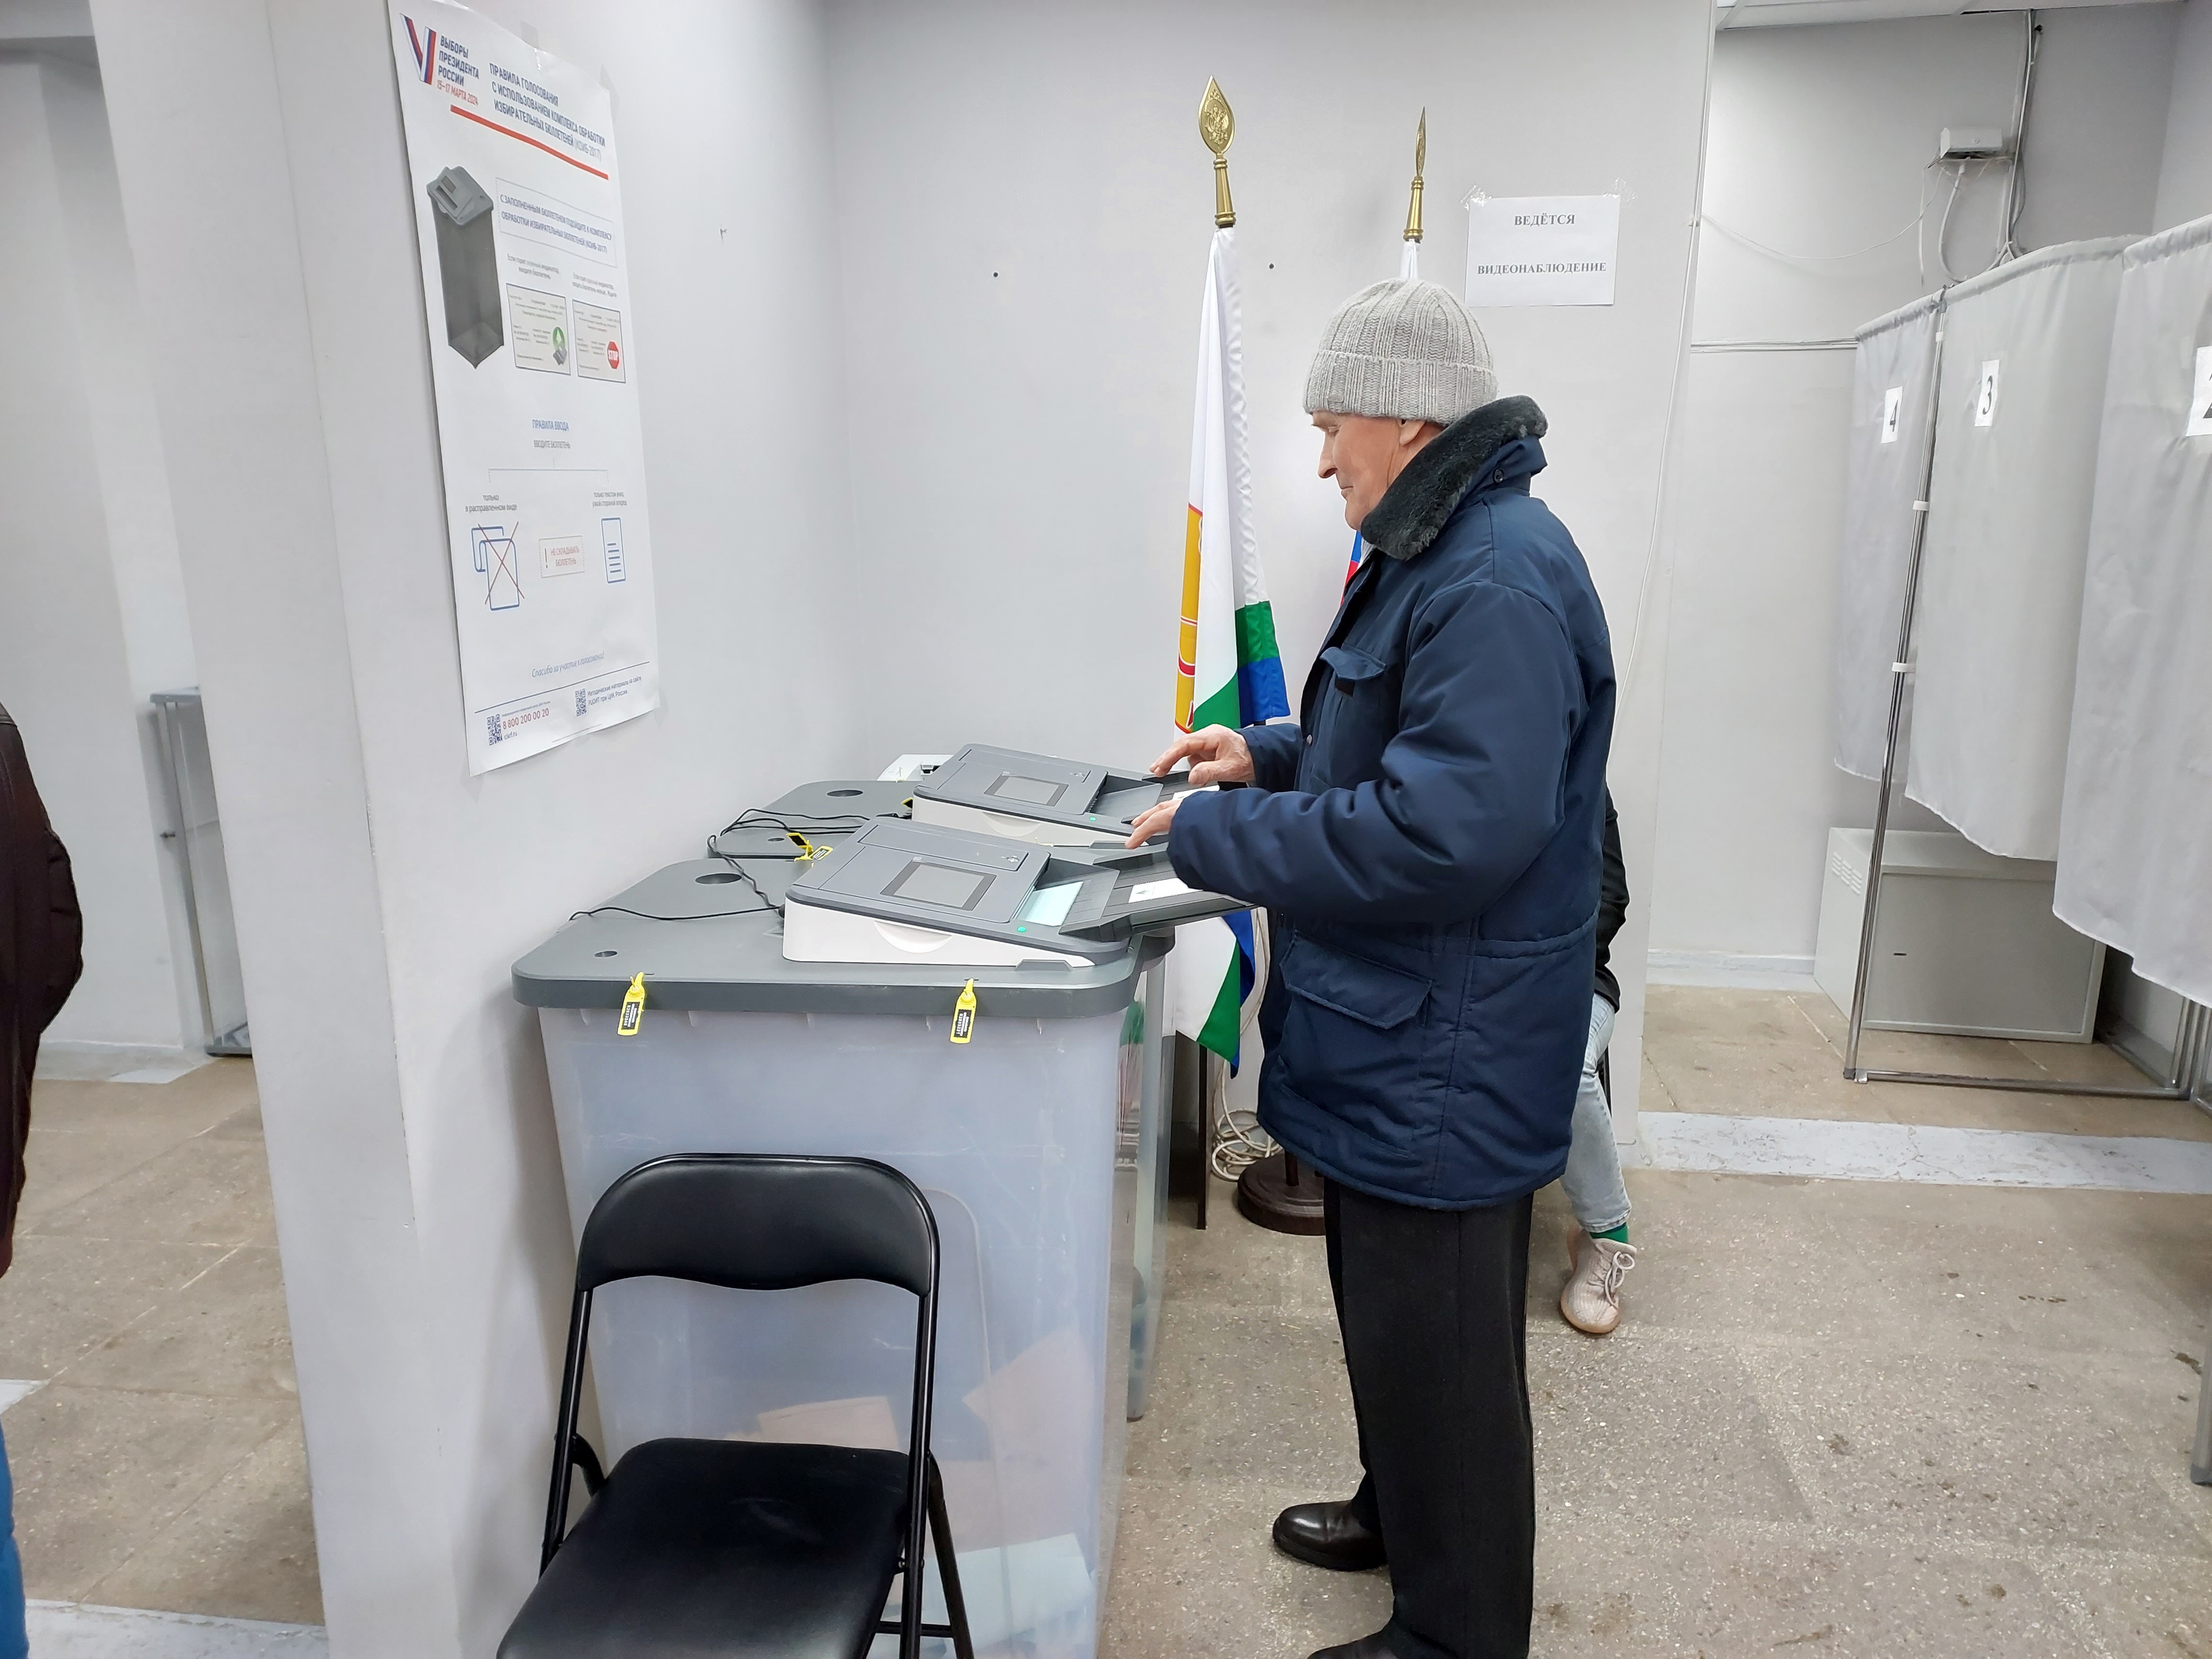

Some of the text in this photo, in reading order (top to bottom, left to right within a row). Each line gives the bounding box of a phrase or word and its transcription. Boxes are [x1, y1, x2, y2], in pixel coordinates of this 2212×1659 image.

[441, 35, 468, 59] ВЫБОРЫ
[439, 50, 479, 79] ПРЕЗИДЕНТА
[438, 65, 464, 87] РОССИИ
[490, 63, 558, 107] ПРАВИЛА ГОЛОСОВАНИЯ
[451, 85, 466, 101] МАРТА
[492, 80, 605, 147] С ИСПОЛЬЗОВАНИЕМ КОМПЛЕКСА ОБРАБОТКИ
[494, 99, 544, 131] ИЗБИРАТЕЛЬНЫХ
[545, 122, 574, 147] БЮЛЛЕТЕНЕЙ
[500, 194, 504, 203] С
[1515, 213, 1575, 227] ВЕДЁТСЯ
[1477, 263, 1606, 276] ВИДЕОНАБЛЮДЕНИЕ
[1982, 376, 1993, 415] 3
[532, 419, 569, 432] ПРАВИЛА ВВОДА
[1889, 399, 1898, 431] 4
[532, 665, 553, 677] Спасибо
[559, 660, 577, 673] участие
[633, 675, 641, 683] сайте
[615, 688, 628, 697] России
[503, 707, 549, 730] 8 800 200 00 20
